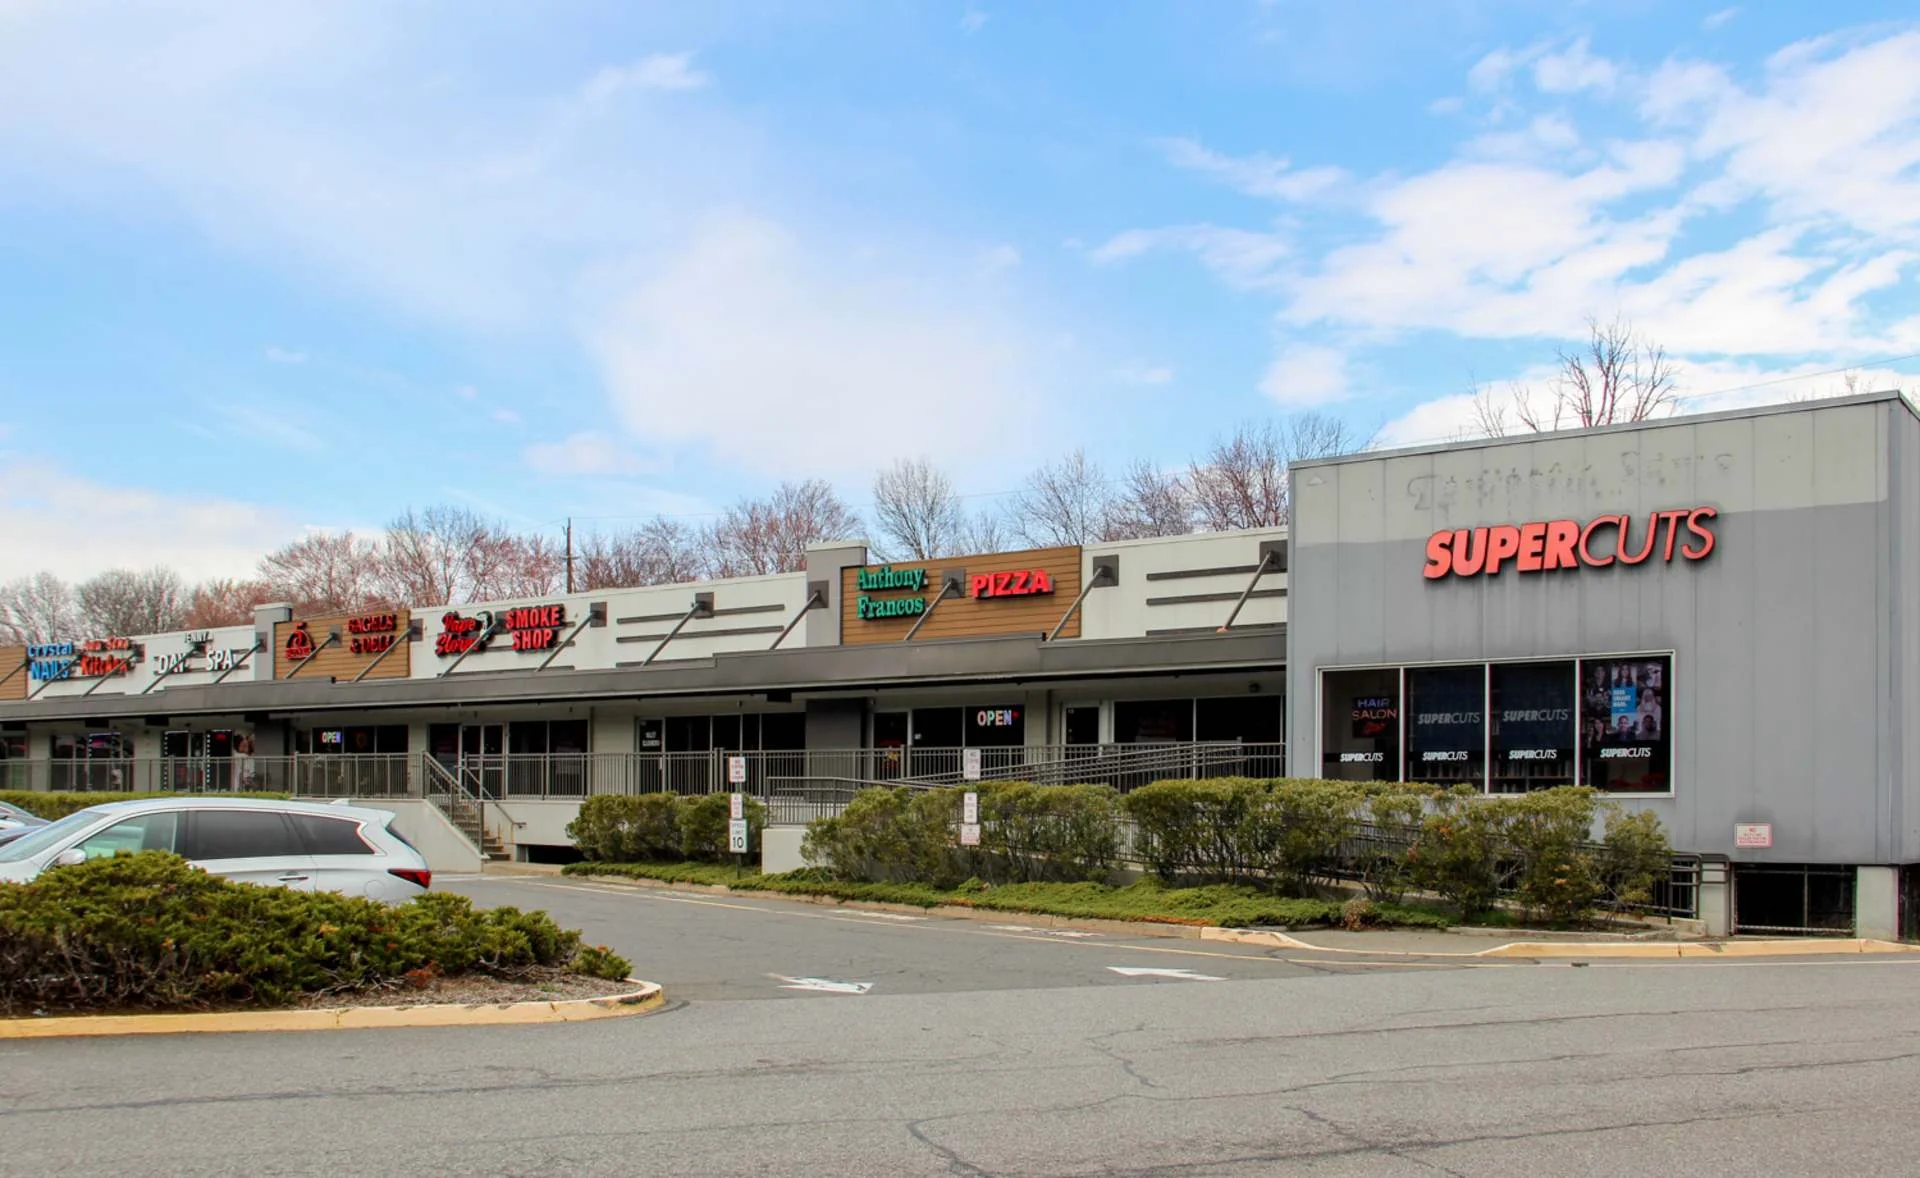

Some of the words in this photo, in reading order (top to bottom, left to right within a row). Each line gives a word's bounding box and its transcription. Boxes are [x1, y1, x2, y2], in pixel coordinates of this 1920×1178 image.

[1423, 506, 1718, 579] SUPERCUTS
[970, 569, 1051, 598] PIZZA
[857, 595, 924, 619] Francos
[506, 605, 560, 630] SMOKE
[512, 629, 553, 650] SHOP
[28, 640, 73, 657] Crystal
[159, 652, 187, 673] DAY
[206, 648, 234, 671] SPA
[31, 659, 70, 680] NAILS
[1357, 698, 1391, 707] HAIR
[977, 710, 1012, 726] OPEN
[1352, 709, 1398, 720] SALON
[1418, 711, 1480, 724] SUPERCUTS
[1503, 709, 1568, 722] SUPERCUTS
[321, 731, 342, 744] OPEN
[1340, 752, 1384, 762] SUPERCUTS
[1423, 751, 1468, 761] SUPERCUTS
[1509, 749, 1557, 760] SUPERCUTS
[1600, 747, 1652, 758] SUPERCUTS
[732, 836, 744, 848] 10
